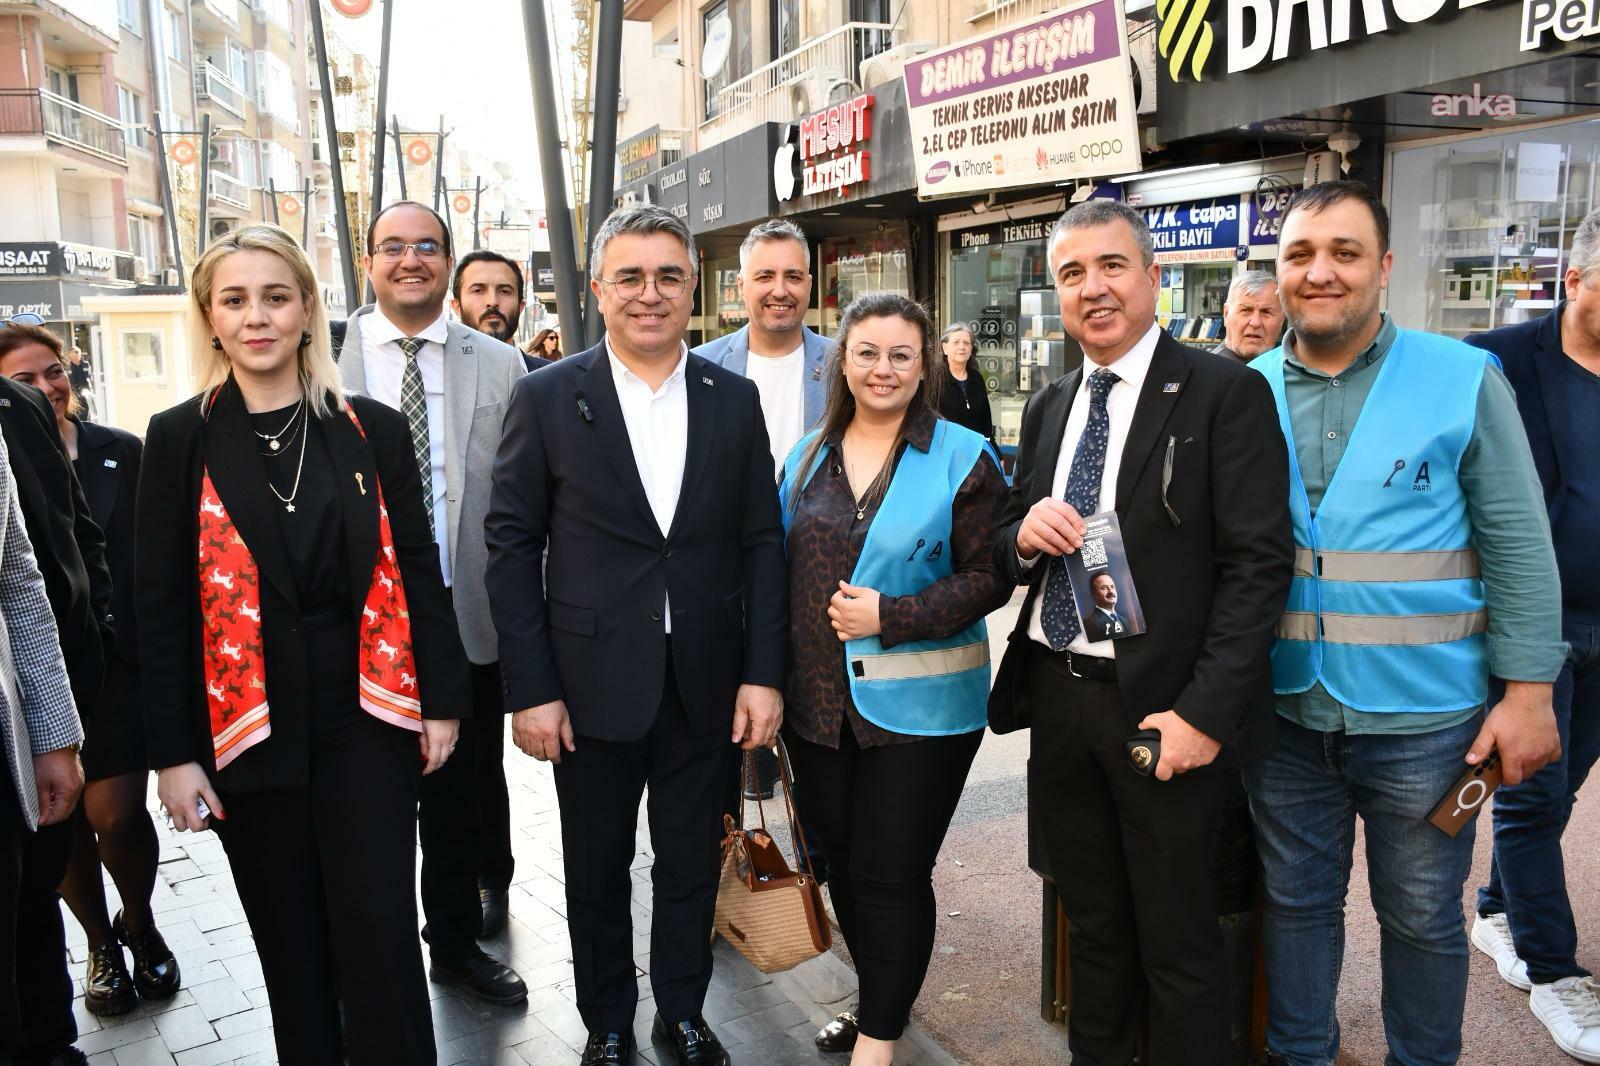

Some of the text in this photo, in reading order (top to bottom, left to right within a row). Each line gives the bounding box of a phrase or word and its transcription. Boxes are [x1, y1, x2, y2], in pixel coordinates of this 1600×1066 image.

[1017, 73, 1090, 110] AKSESUAR
[800, 94, 869, 160] MESUT
[947, 128, 967, 150] CEP
[971, 117, 1028, 148] TELEFONU
[1032, 108, 1066, 136] ALIM
[1070, 97, 1118, 130] SATIM
[962, 158, 993, 178] iPhone
[1050, 151, 1076, 166] HUAWEI
[1262, 192, 1290, 213] DE
[961, 232, 990, 248] iPhone
